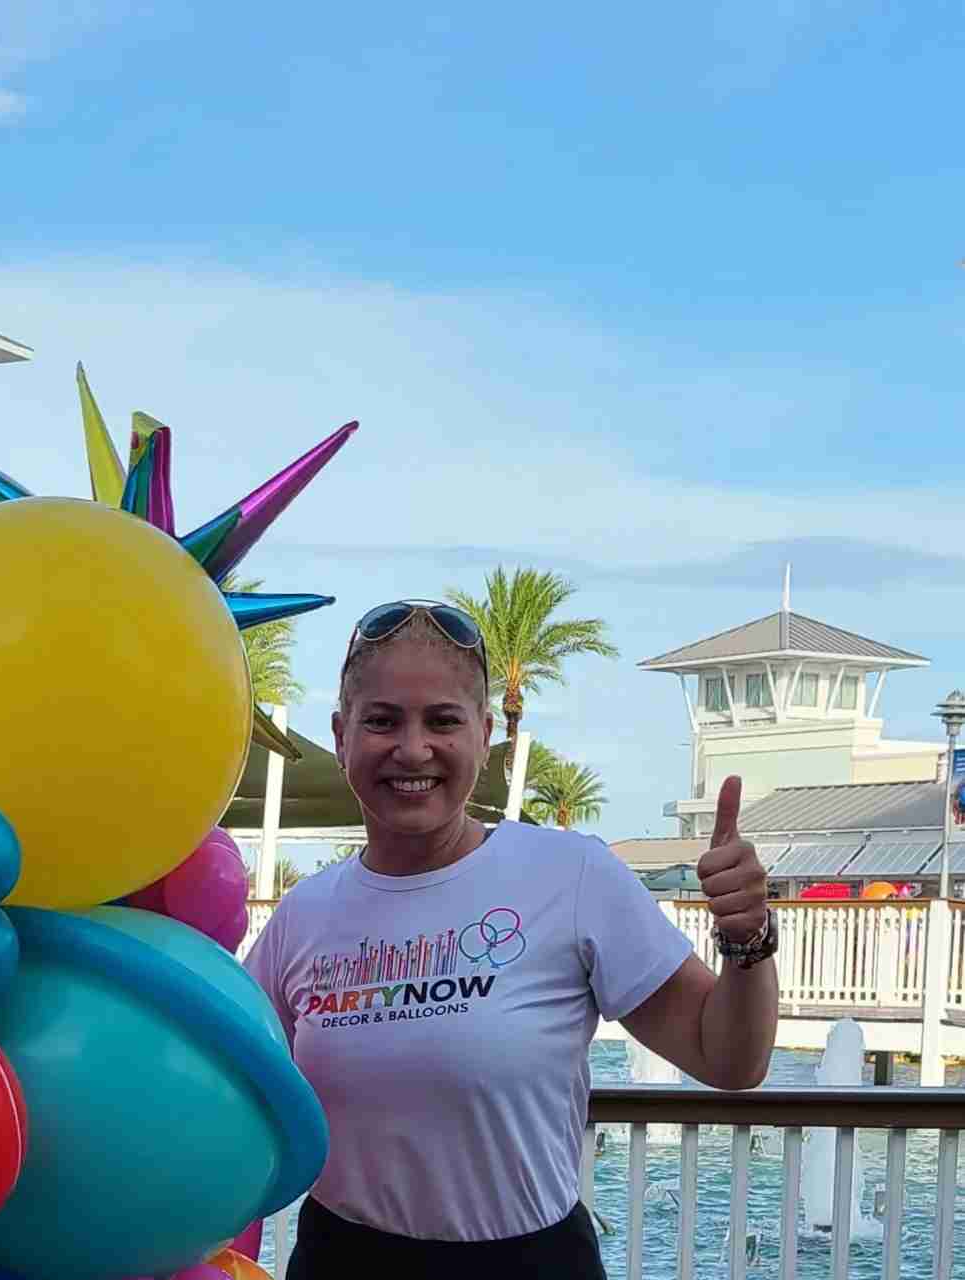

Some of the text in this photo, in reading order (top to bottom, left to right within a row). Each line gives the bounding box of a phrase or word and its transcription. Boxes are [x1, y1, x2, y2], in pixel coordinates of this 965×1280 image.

[321, 1002, 470, 1029] DECOR & BALLOONS
